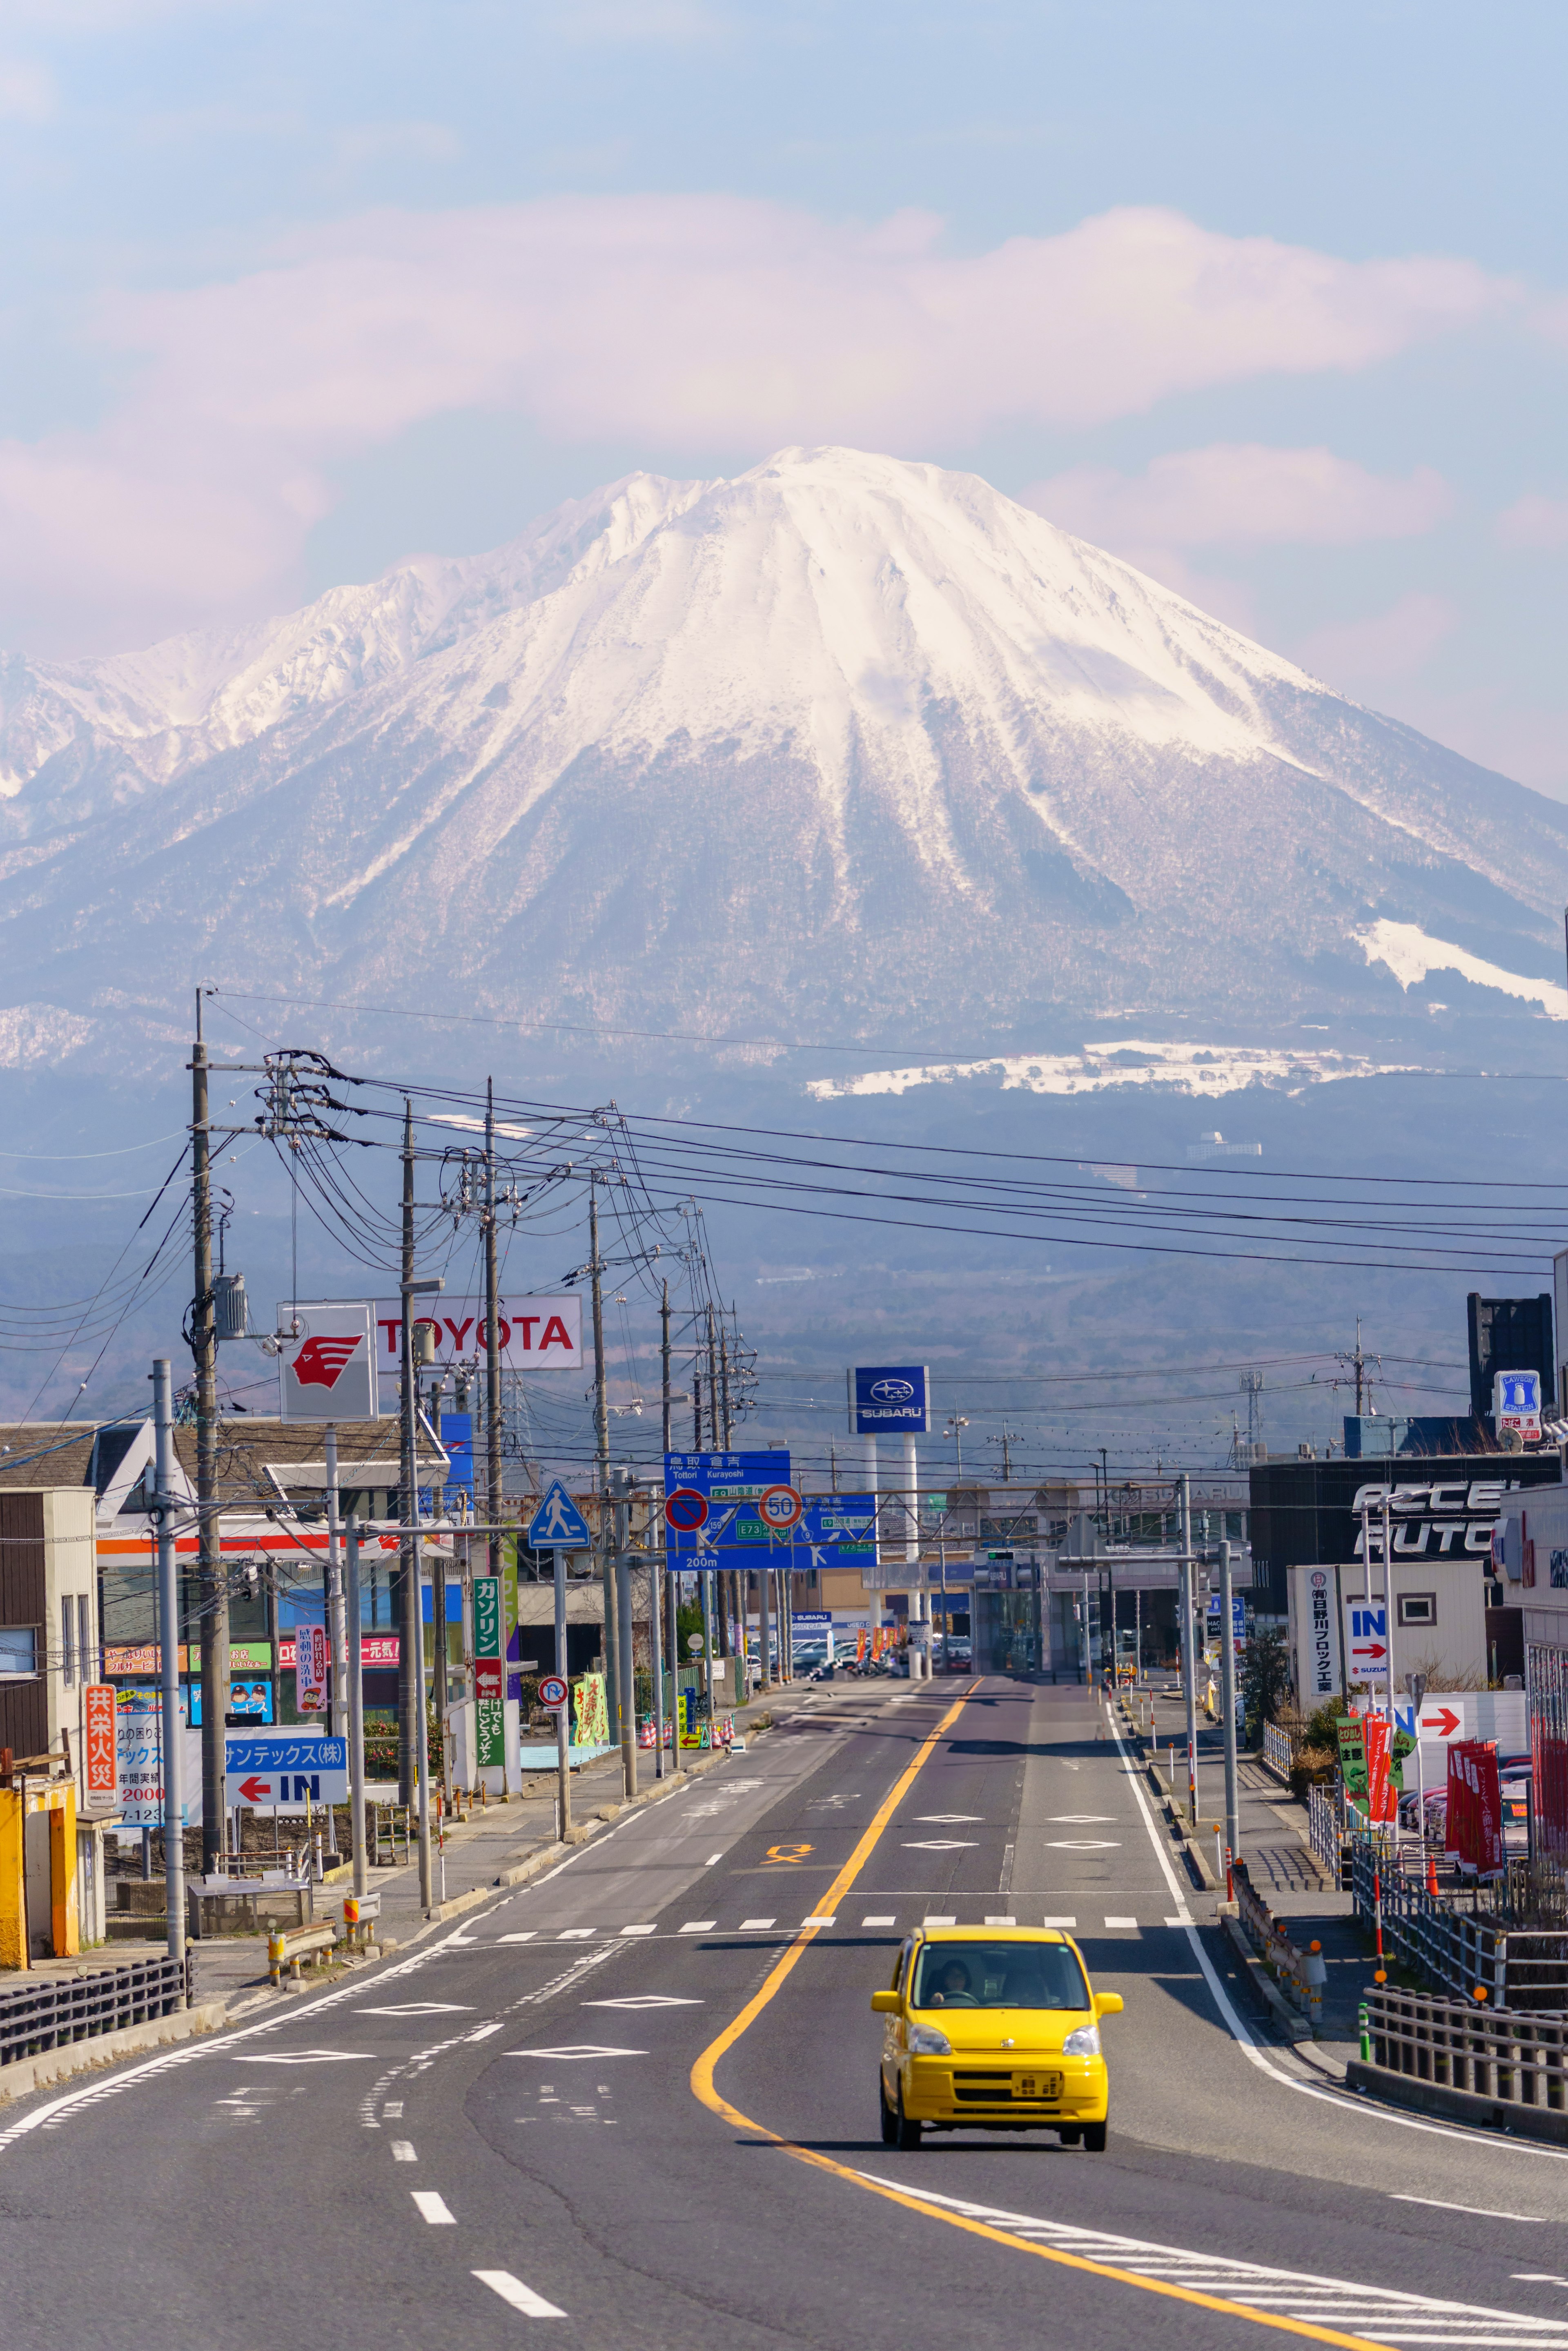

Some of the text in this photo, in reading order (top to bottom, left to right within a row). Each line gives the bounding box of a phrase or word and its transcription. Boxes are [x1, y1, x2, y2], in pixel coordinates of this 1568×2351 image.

[1504, 1376, 1534, 1384] LAWSON
[862, 1408, 922, 1418] SUBARU
[1505, 1403, 1534, 1411] STATION
[1502, 1419, 1520, 1428] たばこ
[669, 1455, 740, 1470] 鳥取 倉吉
[707, 1470, 744, 1479] Kurayoshi
[769, 1498, 792, 1516] 50
[710, 1521, 722, 1529] 159
[686, 1558, 717, 1567] 200m
[477, 1582, 497, 1653] ガソリン
[1352, 1609, 1386, 1637] IN
[1312, 1589, 1332, 1692] (有)日野川ブロック工業
[299, 1628, 312, 1688] 感動の洗車
[314, 1634, 323, 1678] 選ばれる店
[481, 1689, 496, 1698] IN
[89, 1689, 112, 1787] 共栄火災
[1341, 1748, 1363, 1761] 注意
[119, 1772, 159, 1785] 年間実績
[281, 1775, 320, 1801] IN
